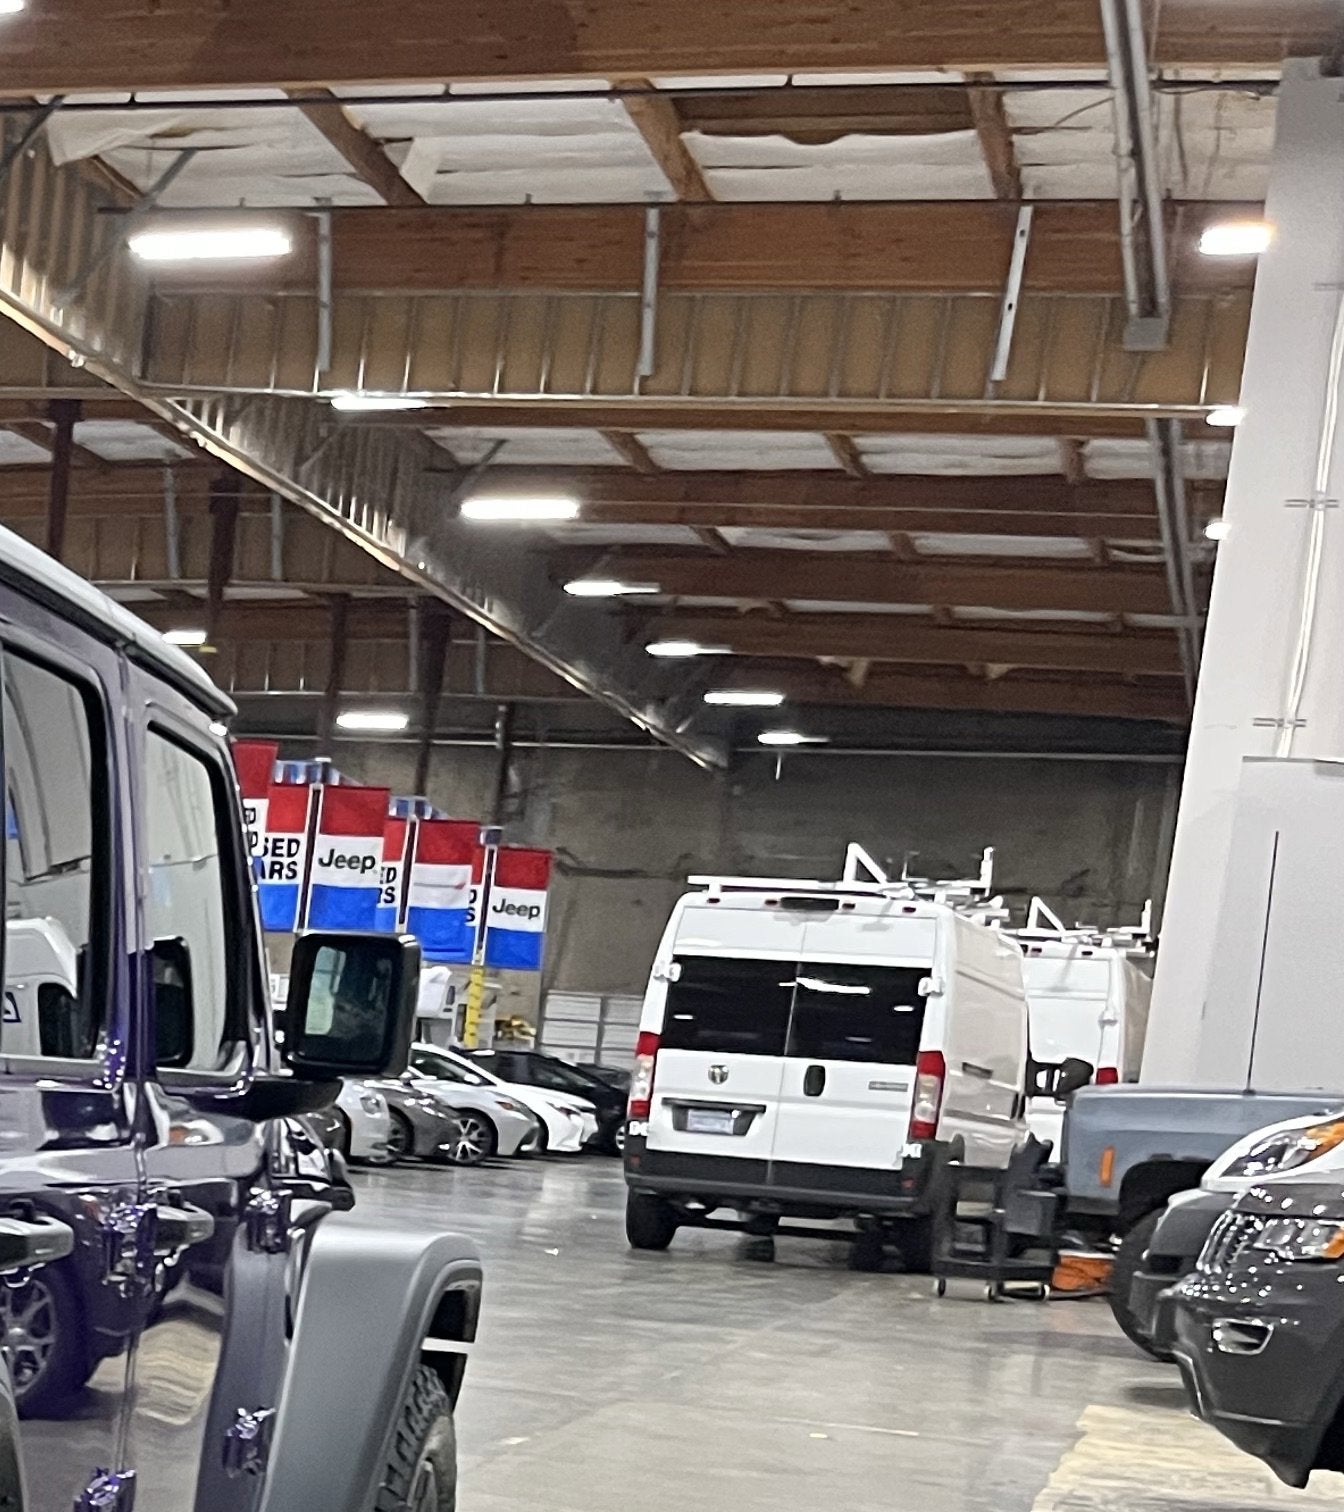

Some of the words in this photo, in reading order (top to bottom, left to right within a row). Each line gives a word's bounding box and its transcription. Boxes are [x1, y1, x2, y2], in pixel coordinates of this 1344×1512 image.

[262, 838, 300, 858] ED
[261, 861, 298, 880] RS
[318, 849, 376, 874] Jeep
[492, 898, 541, 920] Jeep
